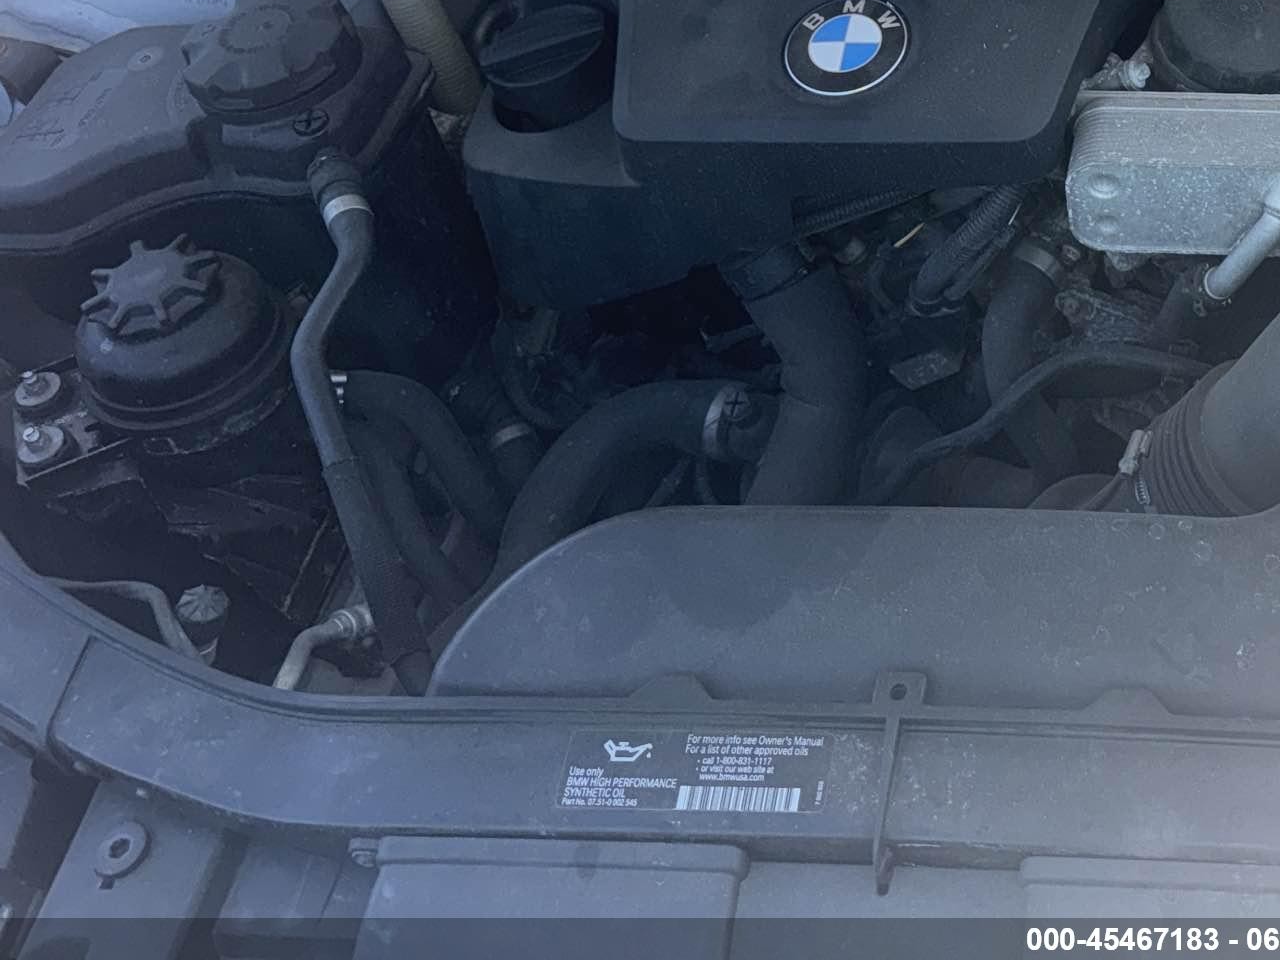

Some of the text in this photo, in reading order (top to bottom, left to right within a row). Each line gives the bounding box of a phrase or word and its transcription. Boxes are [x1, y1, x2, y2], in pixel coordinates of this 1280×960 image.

[802, 0, 903, 31] BMW
[687, 734, 824, 746] For more info see Owner's Manual
[685, 744, 700, 754] For
[707, 744, 720, 754] list
[721, 745, 730, 754] of
[731, 745, 753, 755] other
[754, 746, 793, 757] approved
[794, 747, 809, 756] oils
[702, 757, 714, 765] call
[569, 766, 604, 778] Use only
[699, 773, 765, 782] www.bmwusa.com
[566, 777, 678, 789] BMW HIGH PERFORMANCE
[564, 787, 626, 798] SYNTHETIC OIL
